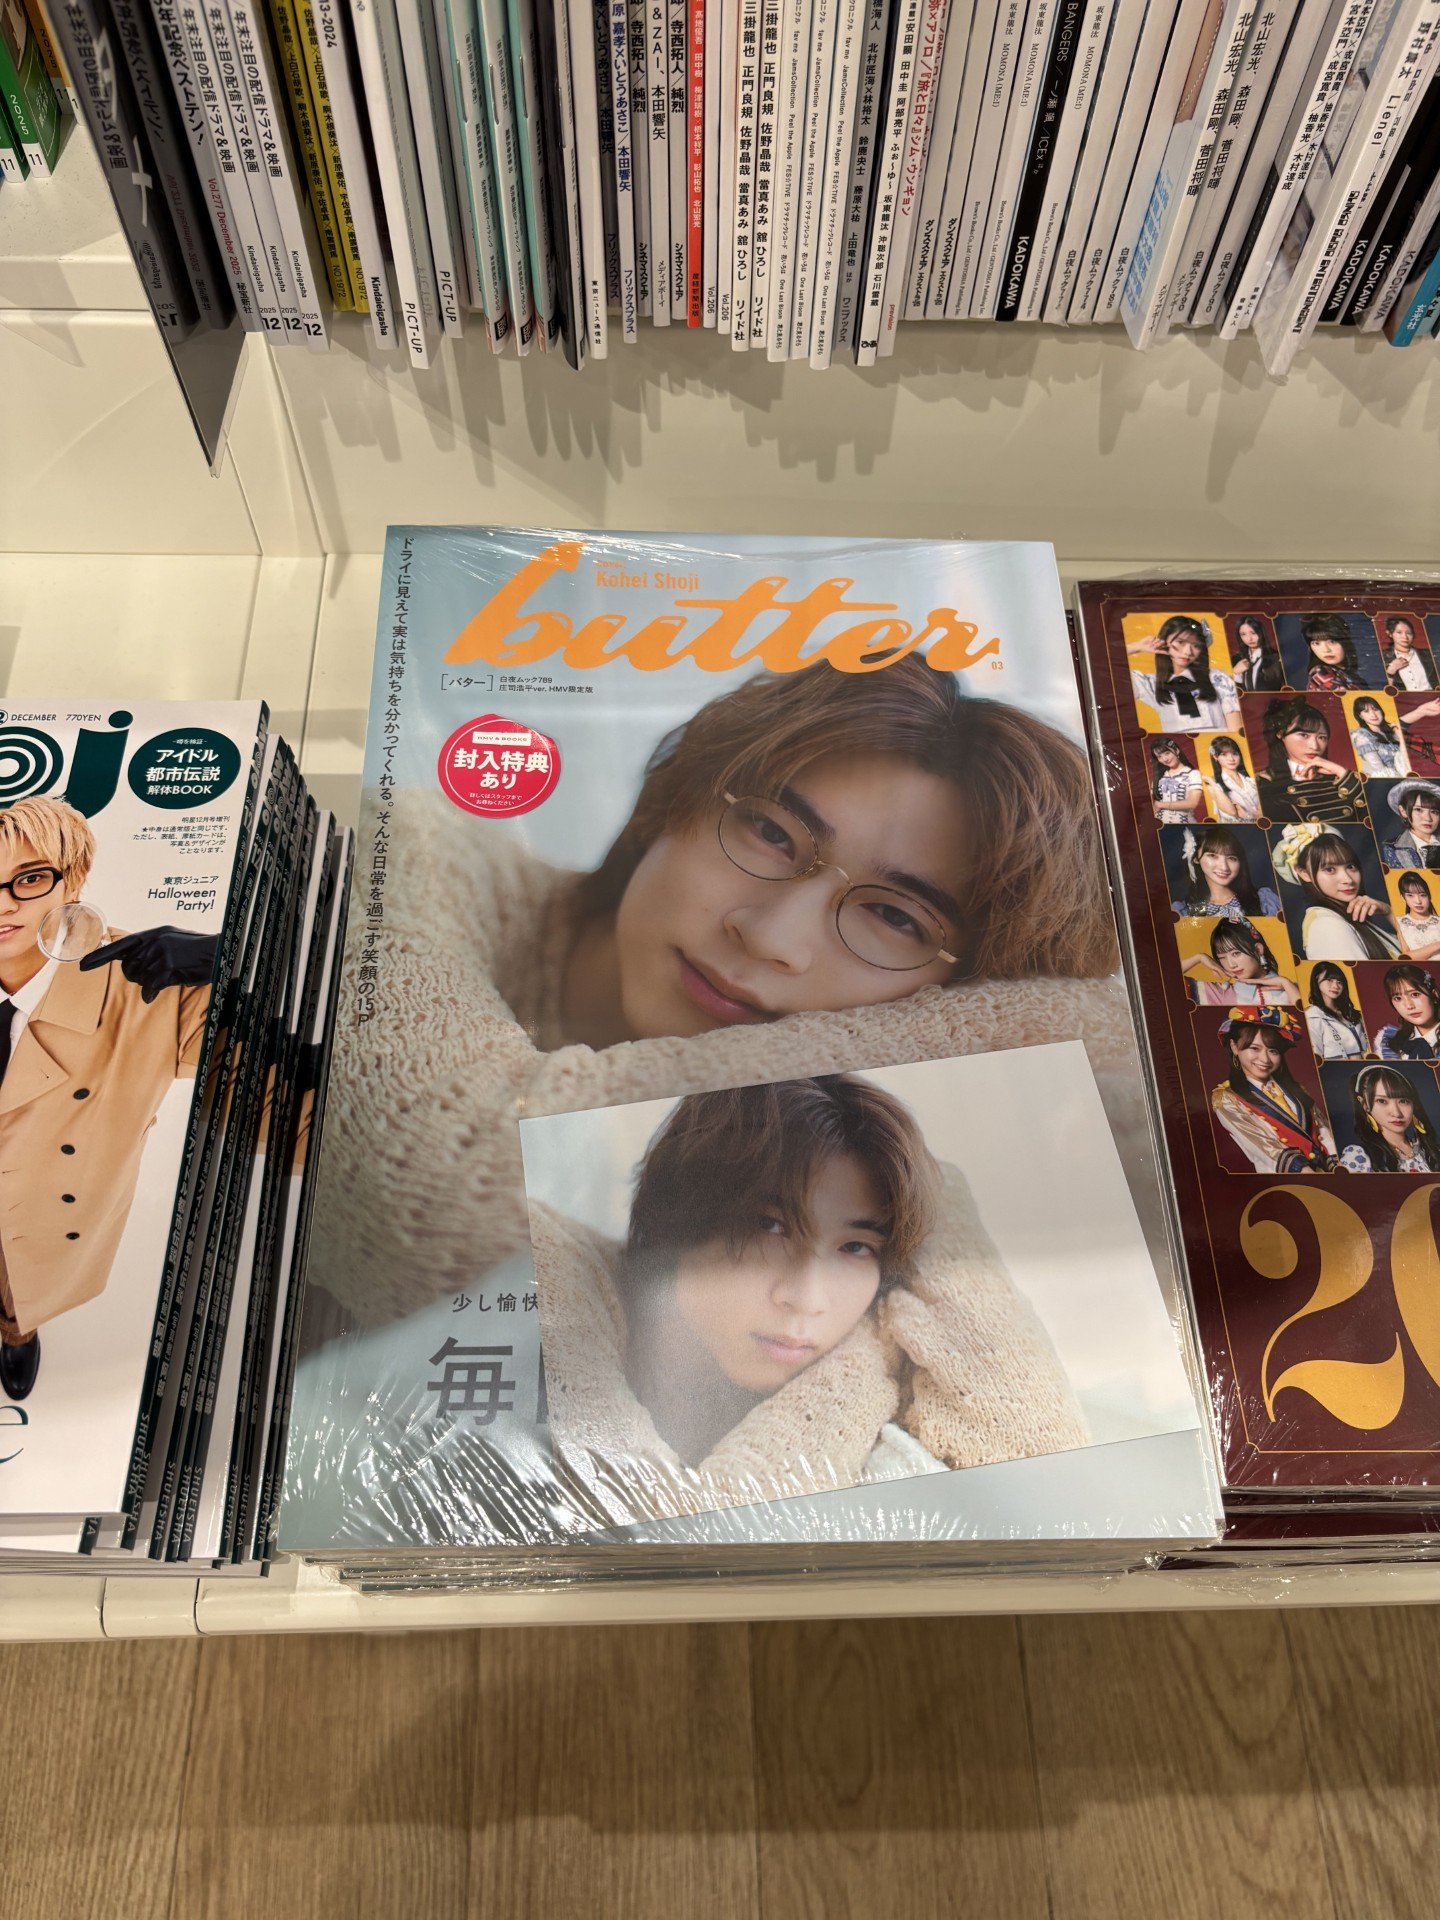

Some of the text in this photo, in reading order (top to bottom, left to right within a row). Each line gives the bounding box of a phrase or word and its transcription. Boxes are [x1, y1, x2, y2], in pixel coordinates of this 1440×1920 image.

[1005, 3, 1018, 35] 坂東龍汰
[1034, 3, 1047, 35] 坂東龍汰
[1056, 2, 1079, 62] BANGERS
[1090, 5, 1105, 38] 坂東龍汰
[694, 53, 703, 78] 田中樹
[792, 43, 798, 53] me
[815, 43, 823, 53] me
[741, 65, 755, 119] 正門良規
[762, 62, 776, 115] 正門良規
[790, 58, 798, 109] JamsCollection
[813, 57, 822, 108] JamsCollection
[839, 64, 849, 115] JamsCollection
[860, 43, 879, 125] 北村匠海×林裕太
[898, 61, 911, 92] 田中圭
[10, 94, 29, 135] 2025
[788, 114, 796, 129] Peel
[810, 129, 818, 139] the
[893, 98, 906, 138] 阿部亮平
[1371, 95, 1401, 146] Lienel
[1, 158, 16, 172] 11
[28, 153, 43, 166] 11
[652, 7, 666, 308] & メディアボーイ
[738, 126, 753, 176] 佐野晶哉
[759, 122, 773, 173] 佐野晶哉
[786, 142, 794, 160] Apple
[808, 140, 816, 159] Apple
[856, 136, 869, 176] 鈴鹿央士
[1035, 136, 1050, 161] ICEx
[692, 200, 702, 228] 北山宏光
[737, 183, 751, 229] 當真あみ
[756, 179, 770, 226] 當真あみ
[851, 185, 864, 223] 藤原大祐
[880, 194, 893, 231] 坂東龍汰
[216, 211, 235, 255] December
[229, 256, 242, 276] 2025
[800, 252, 809, 272] 花いろは
[845, 232, 858, 267] 上田竜也
[919, 219, 935, 270] ダンススクエア
[941, 217, 957, 269] ダンススクエア
[247, 245, 265, 293] Kindaieigasha
[269, 245, 286, 293] Kindaieigasha
[291, 251, 308, 298] Kindaieigasha
[333, 265, 347, 298] NO.1972
[355, 267, 369, 300] NO.1972
[607, 233, 619, 299] フリックスプラス
[638, 242, 649, 300] シネマスクエア
[674, 243, 684, 301] シネマスクエア
[780, 254, 788, 274] 花いろは
[824, 260, 832, 281] 花いろは
[846, 272, 853, 283] ほか
[1004, 236, 1030, 309] KADOKAWA
[1178, 251, 1204, 312] 白夜ムック790
[1206, 252, 1233, 313] 白夜ムック790
[1328, 240, 1369, 310] KADOKAWA
[1352, 245, 1393, 315] KADOKAWA
[440, 270, 457, 322] PICT-UP
[624, 269, 635, 334] フリックスプラス
[707, 286, 716, 314] Vol.206
[1244, 286, 1260, 315] 音楽と人
[1374, 250, 1416, 320] KADOKAWA
[262, 317, 281, 330] 12
[283, 317, 302, 330] 12
[371, 276, 388, 336] Kindaieigasha
[591, 280, 602, 345] 東京ニュース通信社
[721, 294, 730, 321] Vol.206
[734, 300, 746, 341] リイド社
[752, 297, 764, 338] リイド社
[839, 298, 851, 342] ワニブックス
[1149, 284, 1168, 332] メディアボーイ
[1230, 297, 1246, 326] 音楽と人
[304, 323, 323, 336] 12
[405, 302, 423, 354] PICT-UP
[596, 571, 700, 591] Kohei Shoji
[444, 541, 1000, 674] butter
[500, 676, 553, 684] 白夜ムック789
[991, 660, 1004, 671] 03
[66, 714, 102, 722] 770YEN
[145, 766, 221, 782] 都市伝説
[156, 748, 219, 763] アイドル
[454, 748, 550, 773] 封入特典
[147, 784, 213, 796] 解体BOOK
[479, 772, 517, 790] あり
[181, 815, 231, 824] 明星12月号増刊
[147, 887, 217, 899] Halloween
[162, 875, 219, 886] 東京ジュニア
[176, 899, 215, 914] Party!
[452, 1293, 539, 1312] 少し愉快
[128, 1412, 151, 1495] SHUEISHA
[155, 1461, 176, 1541] SHUEISHA
[172, 1465, 192, 1543] SHUEISHA
[183, 1467, 203, 1543] SHUEISHA
[225, 1465, 239, 1540] SHUEISHA
[237, 1474, 251, 1546] SHUEISHA
[258, 1473, 273, 1544] SHUEISHA
